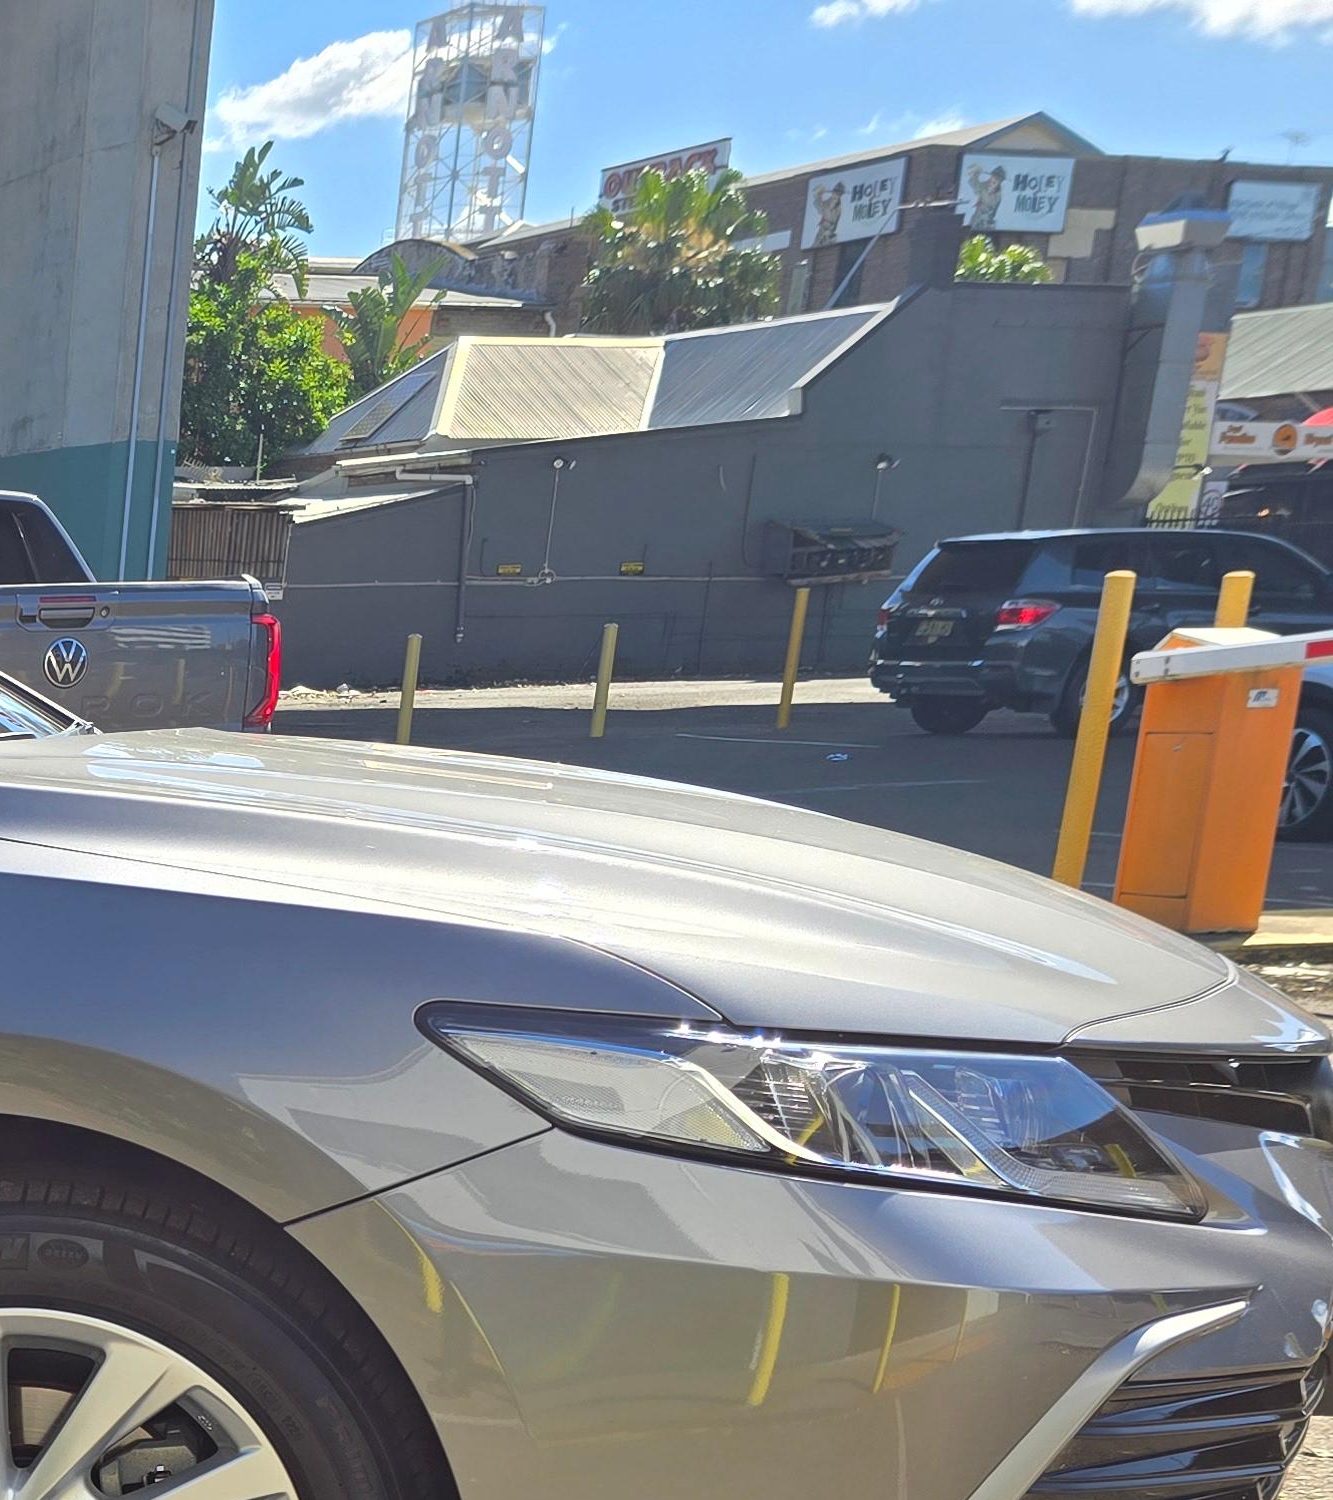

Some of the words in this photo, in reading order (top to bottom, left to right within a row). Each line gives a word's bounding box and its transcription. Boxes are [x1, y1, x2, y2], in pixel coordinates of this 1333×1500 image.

[851, 176, 898, 203] HOLEY
[1011, 173, 1064, 192] HOLEY
[852, 199, 891, 221] MOLEY
[1014, 194, 1060, 214] MOLEY
